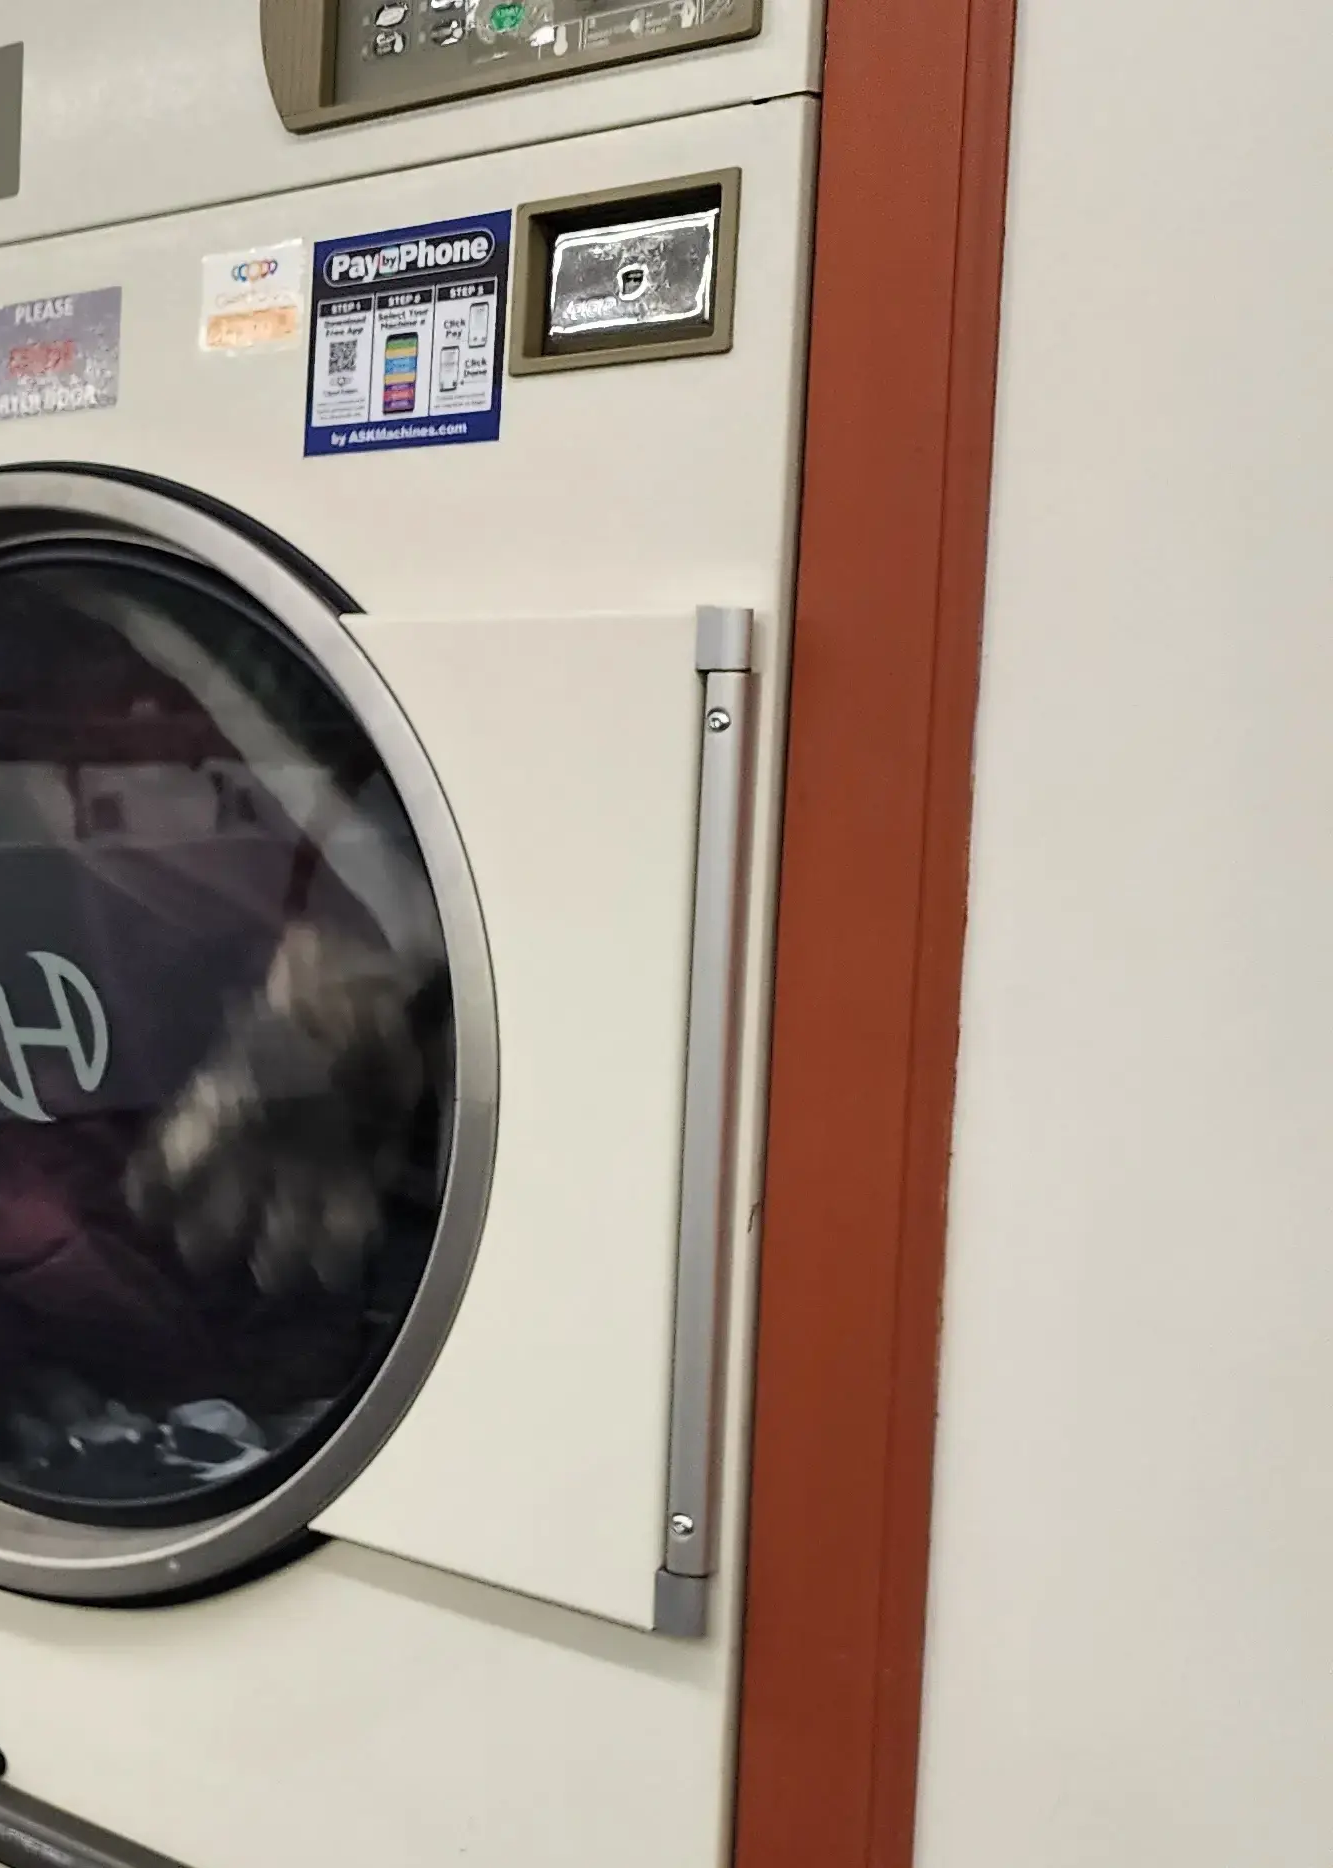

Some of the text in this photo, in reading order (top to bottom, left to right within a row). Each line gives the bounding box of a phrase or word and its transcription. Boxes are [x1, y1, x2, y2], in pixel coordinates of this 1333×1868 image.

[332, 253, 380, 283] Pay
[398, 235, 489, 272] Phone
[14, 297, 75, 326] PLEASE
